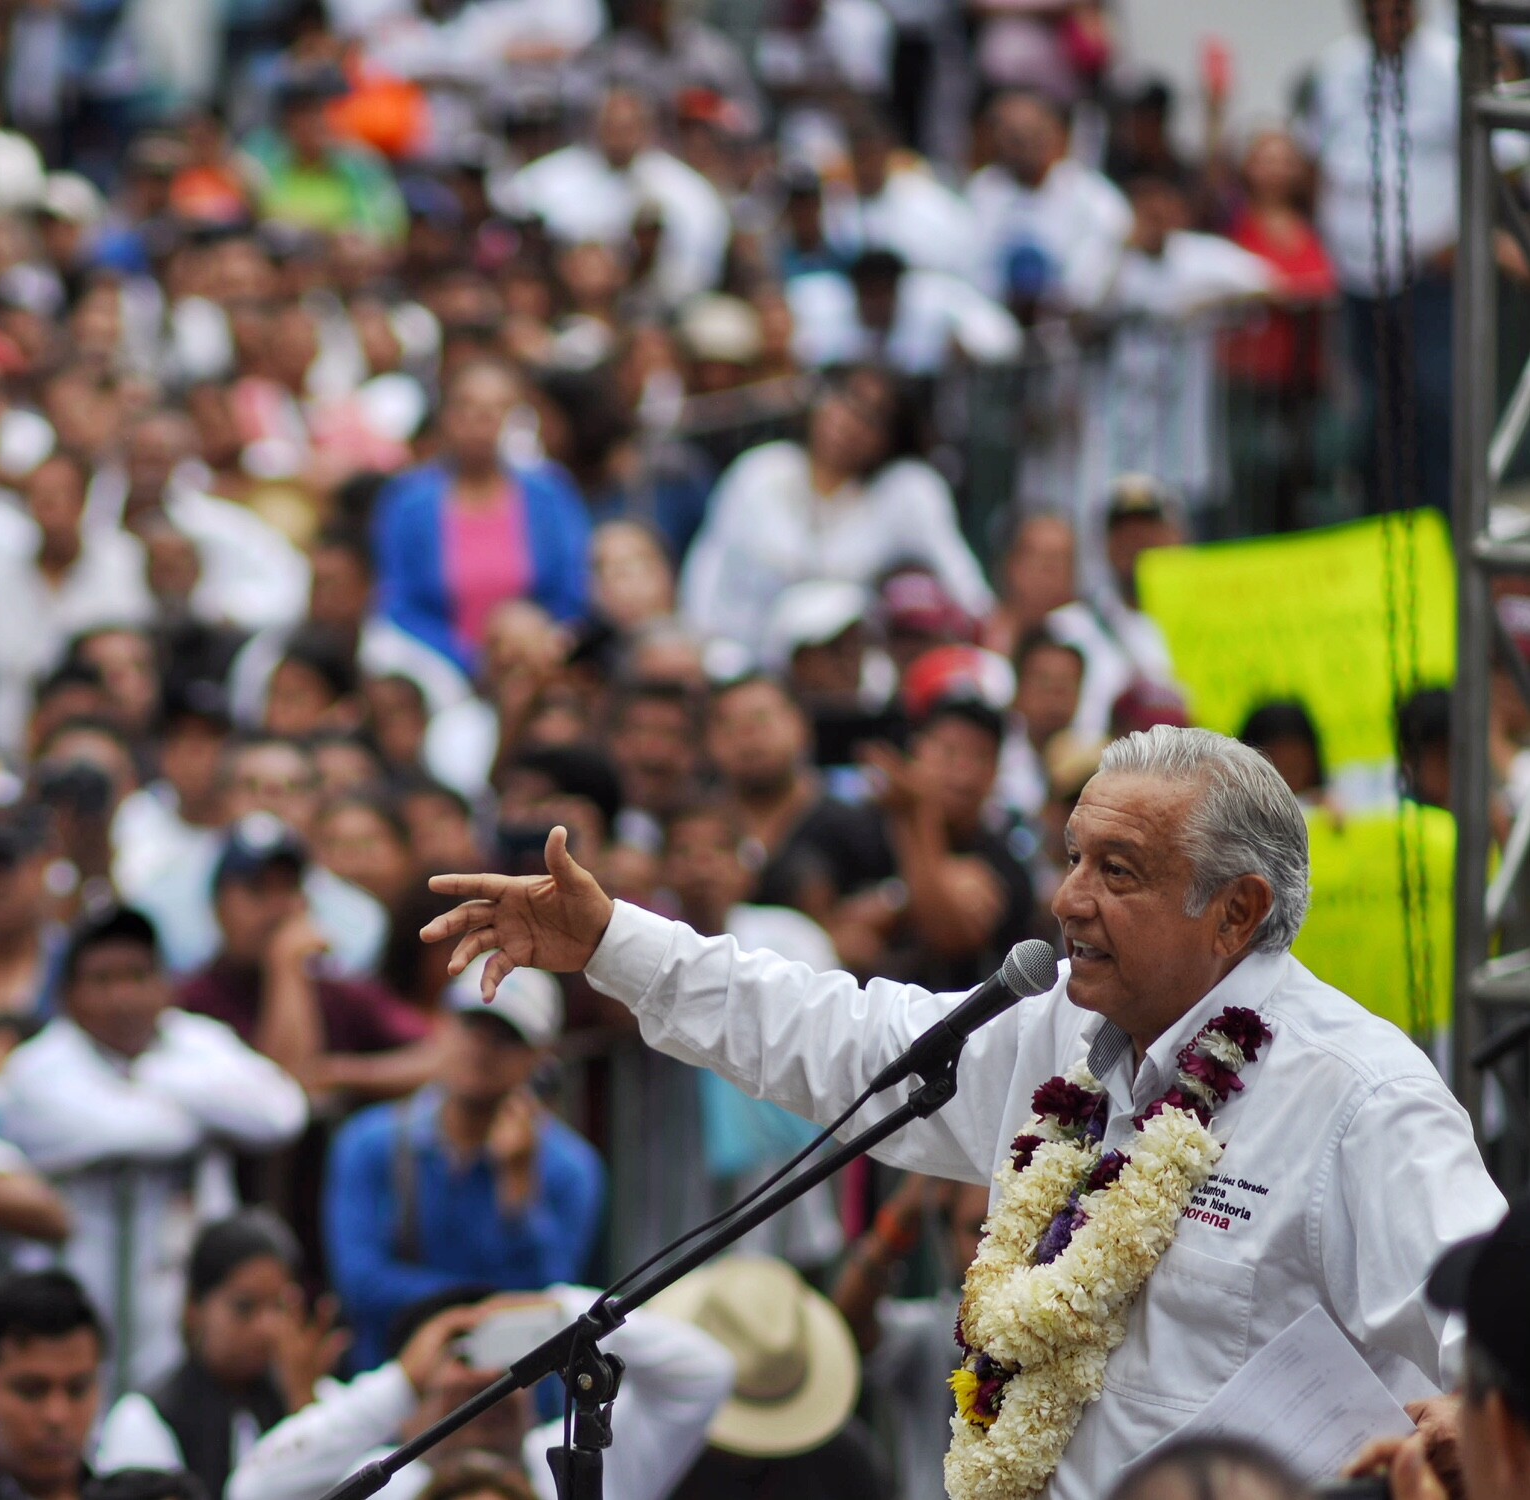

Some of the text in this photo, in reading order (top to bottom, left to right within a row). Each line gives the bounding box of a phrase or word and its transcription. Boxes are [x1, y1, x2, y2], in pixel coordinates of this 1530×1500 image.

[1198, 1183, 1226, 1198] Juntos
[1237, 1179, 1269, 1195] Obrador
[1210, 1198, 1251, 1220] historia
